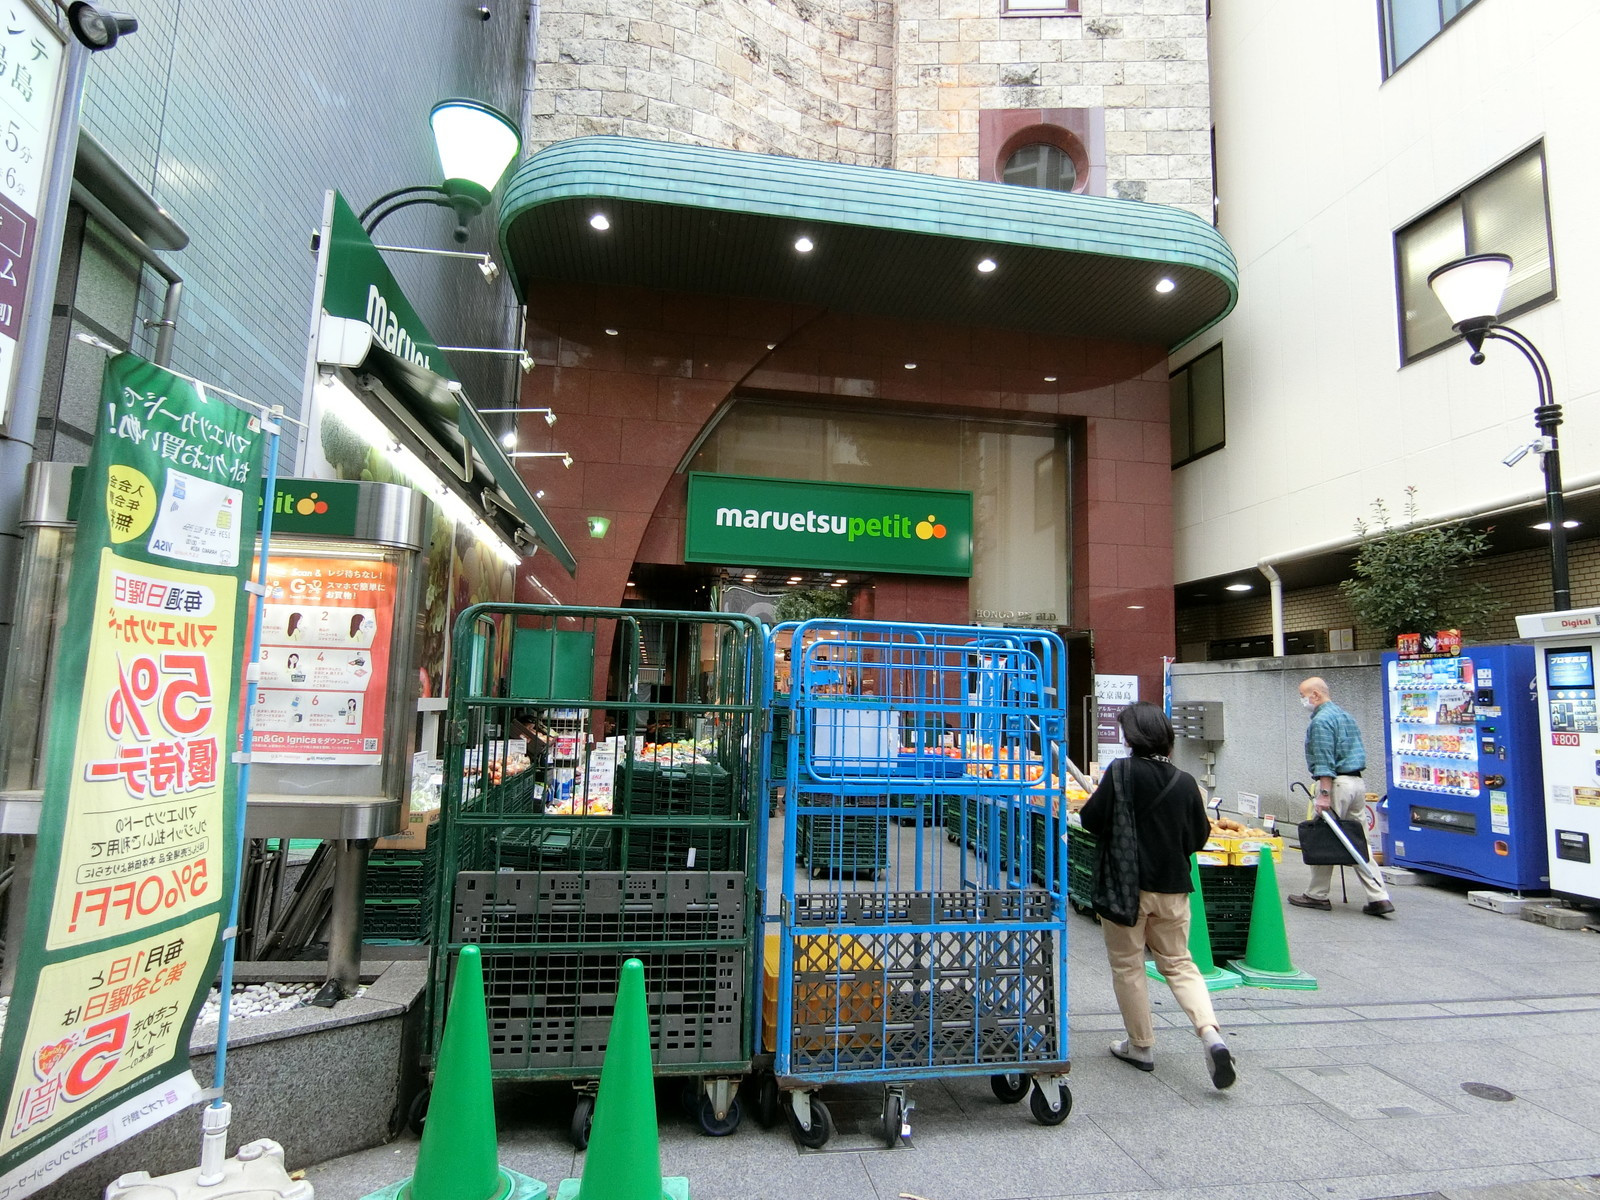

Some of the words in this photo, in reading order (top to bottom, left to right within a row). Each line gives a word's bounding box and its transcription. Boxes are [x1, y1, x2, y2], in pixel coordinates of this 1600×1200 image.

[328, 569, 383, 580] レジ待ちなし!
[321, 611, 329, 621] 2
[1561, 618, 1592, 628] Digital
[261, 651, 269, 660] 3
[317, 652, 324, 661] 4
[258, 693, 266, 704] 5
[311, 695, 319, 706] 6
